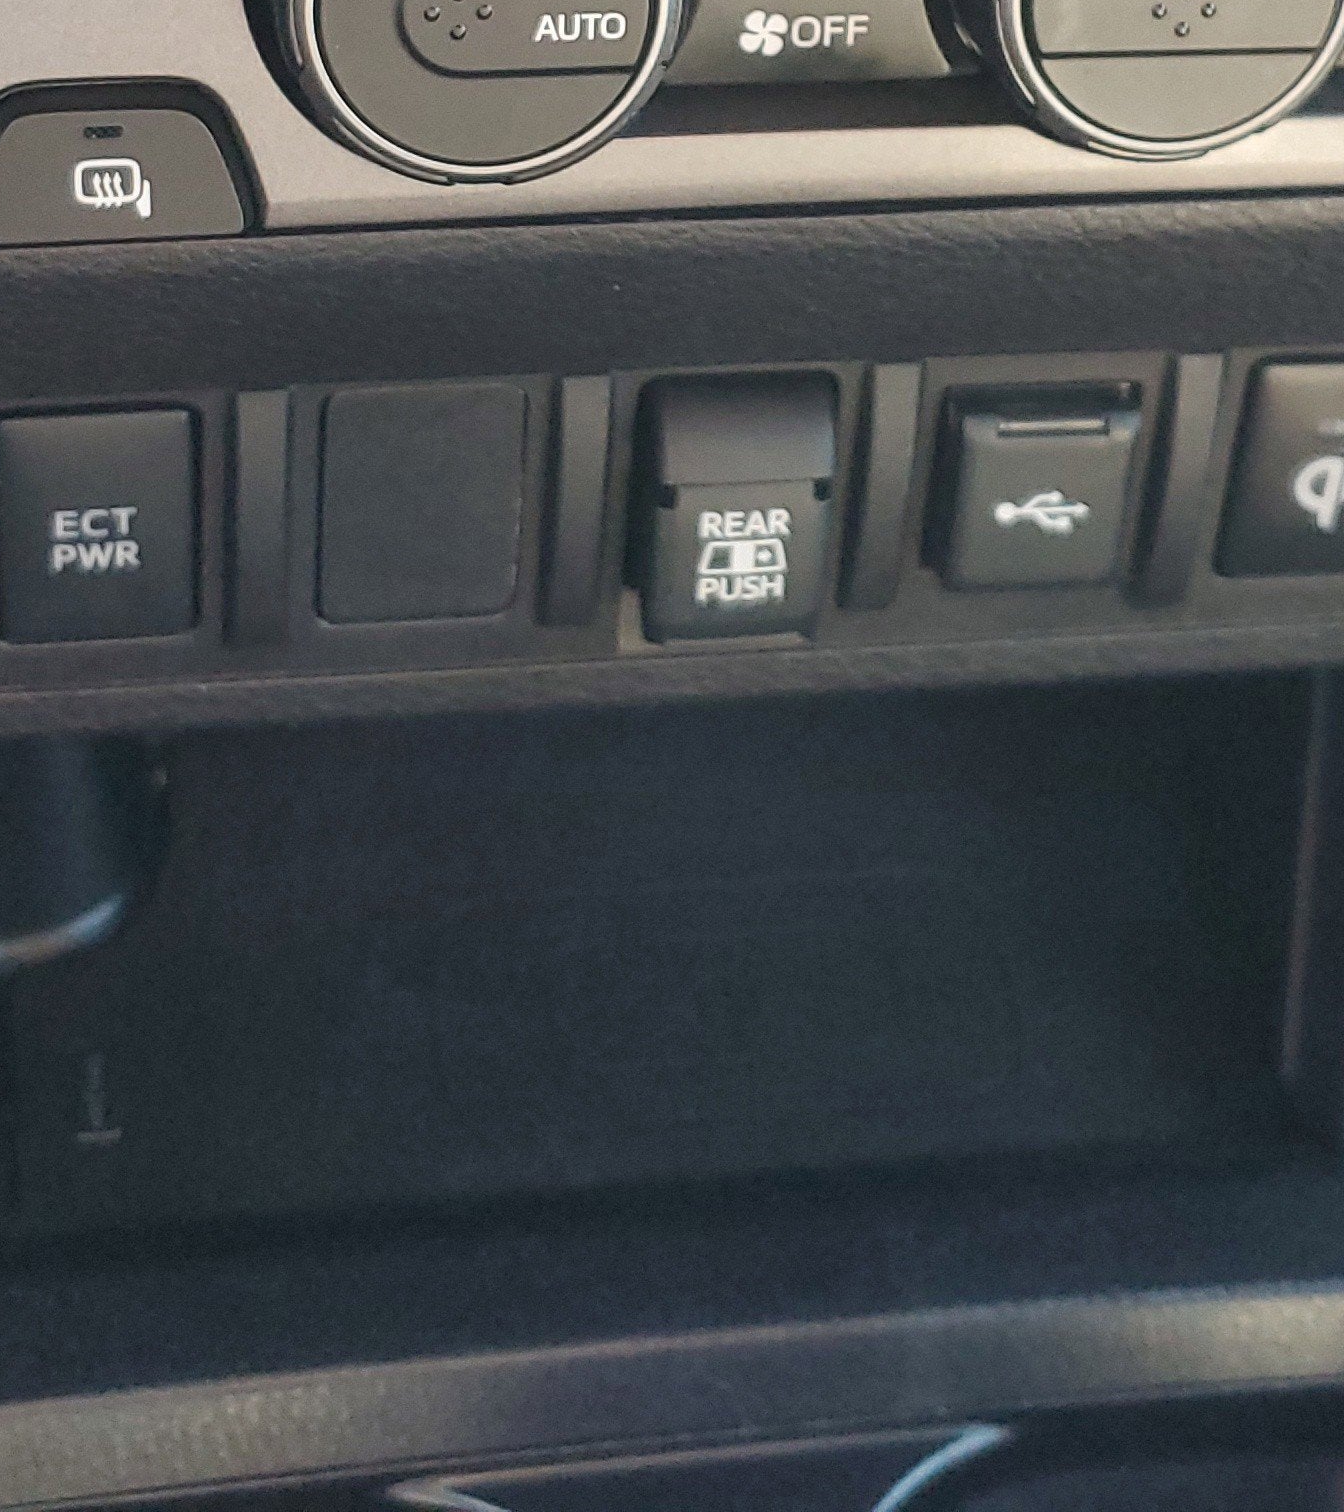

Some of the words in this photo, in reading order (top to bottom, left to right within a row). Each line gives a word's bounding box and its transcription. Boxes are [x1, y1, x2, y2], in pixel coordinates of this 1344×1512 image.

[533, 11, 628, 44] AUTO
[790, 13, 870, 49] OFF
[50, 504, 138, 541] ECT
[697, 507, 792, 540] REAR
[51, 539, 142, 576] PWR
[694, 574, 785, 606] PUSH
